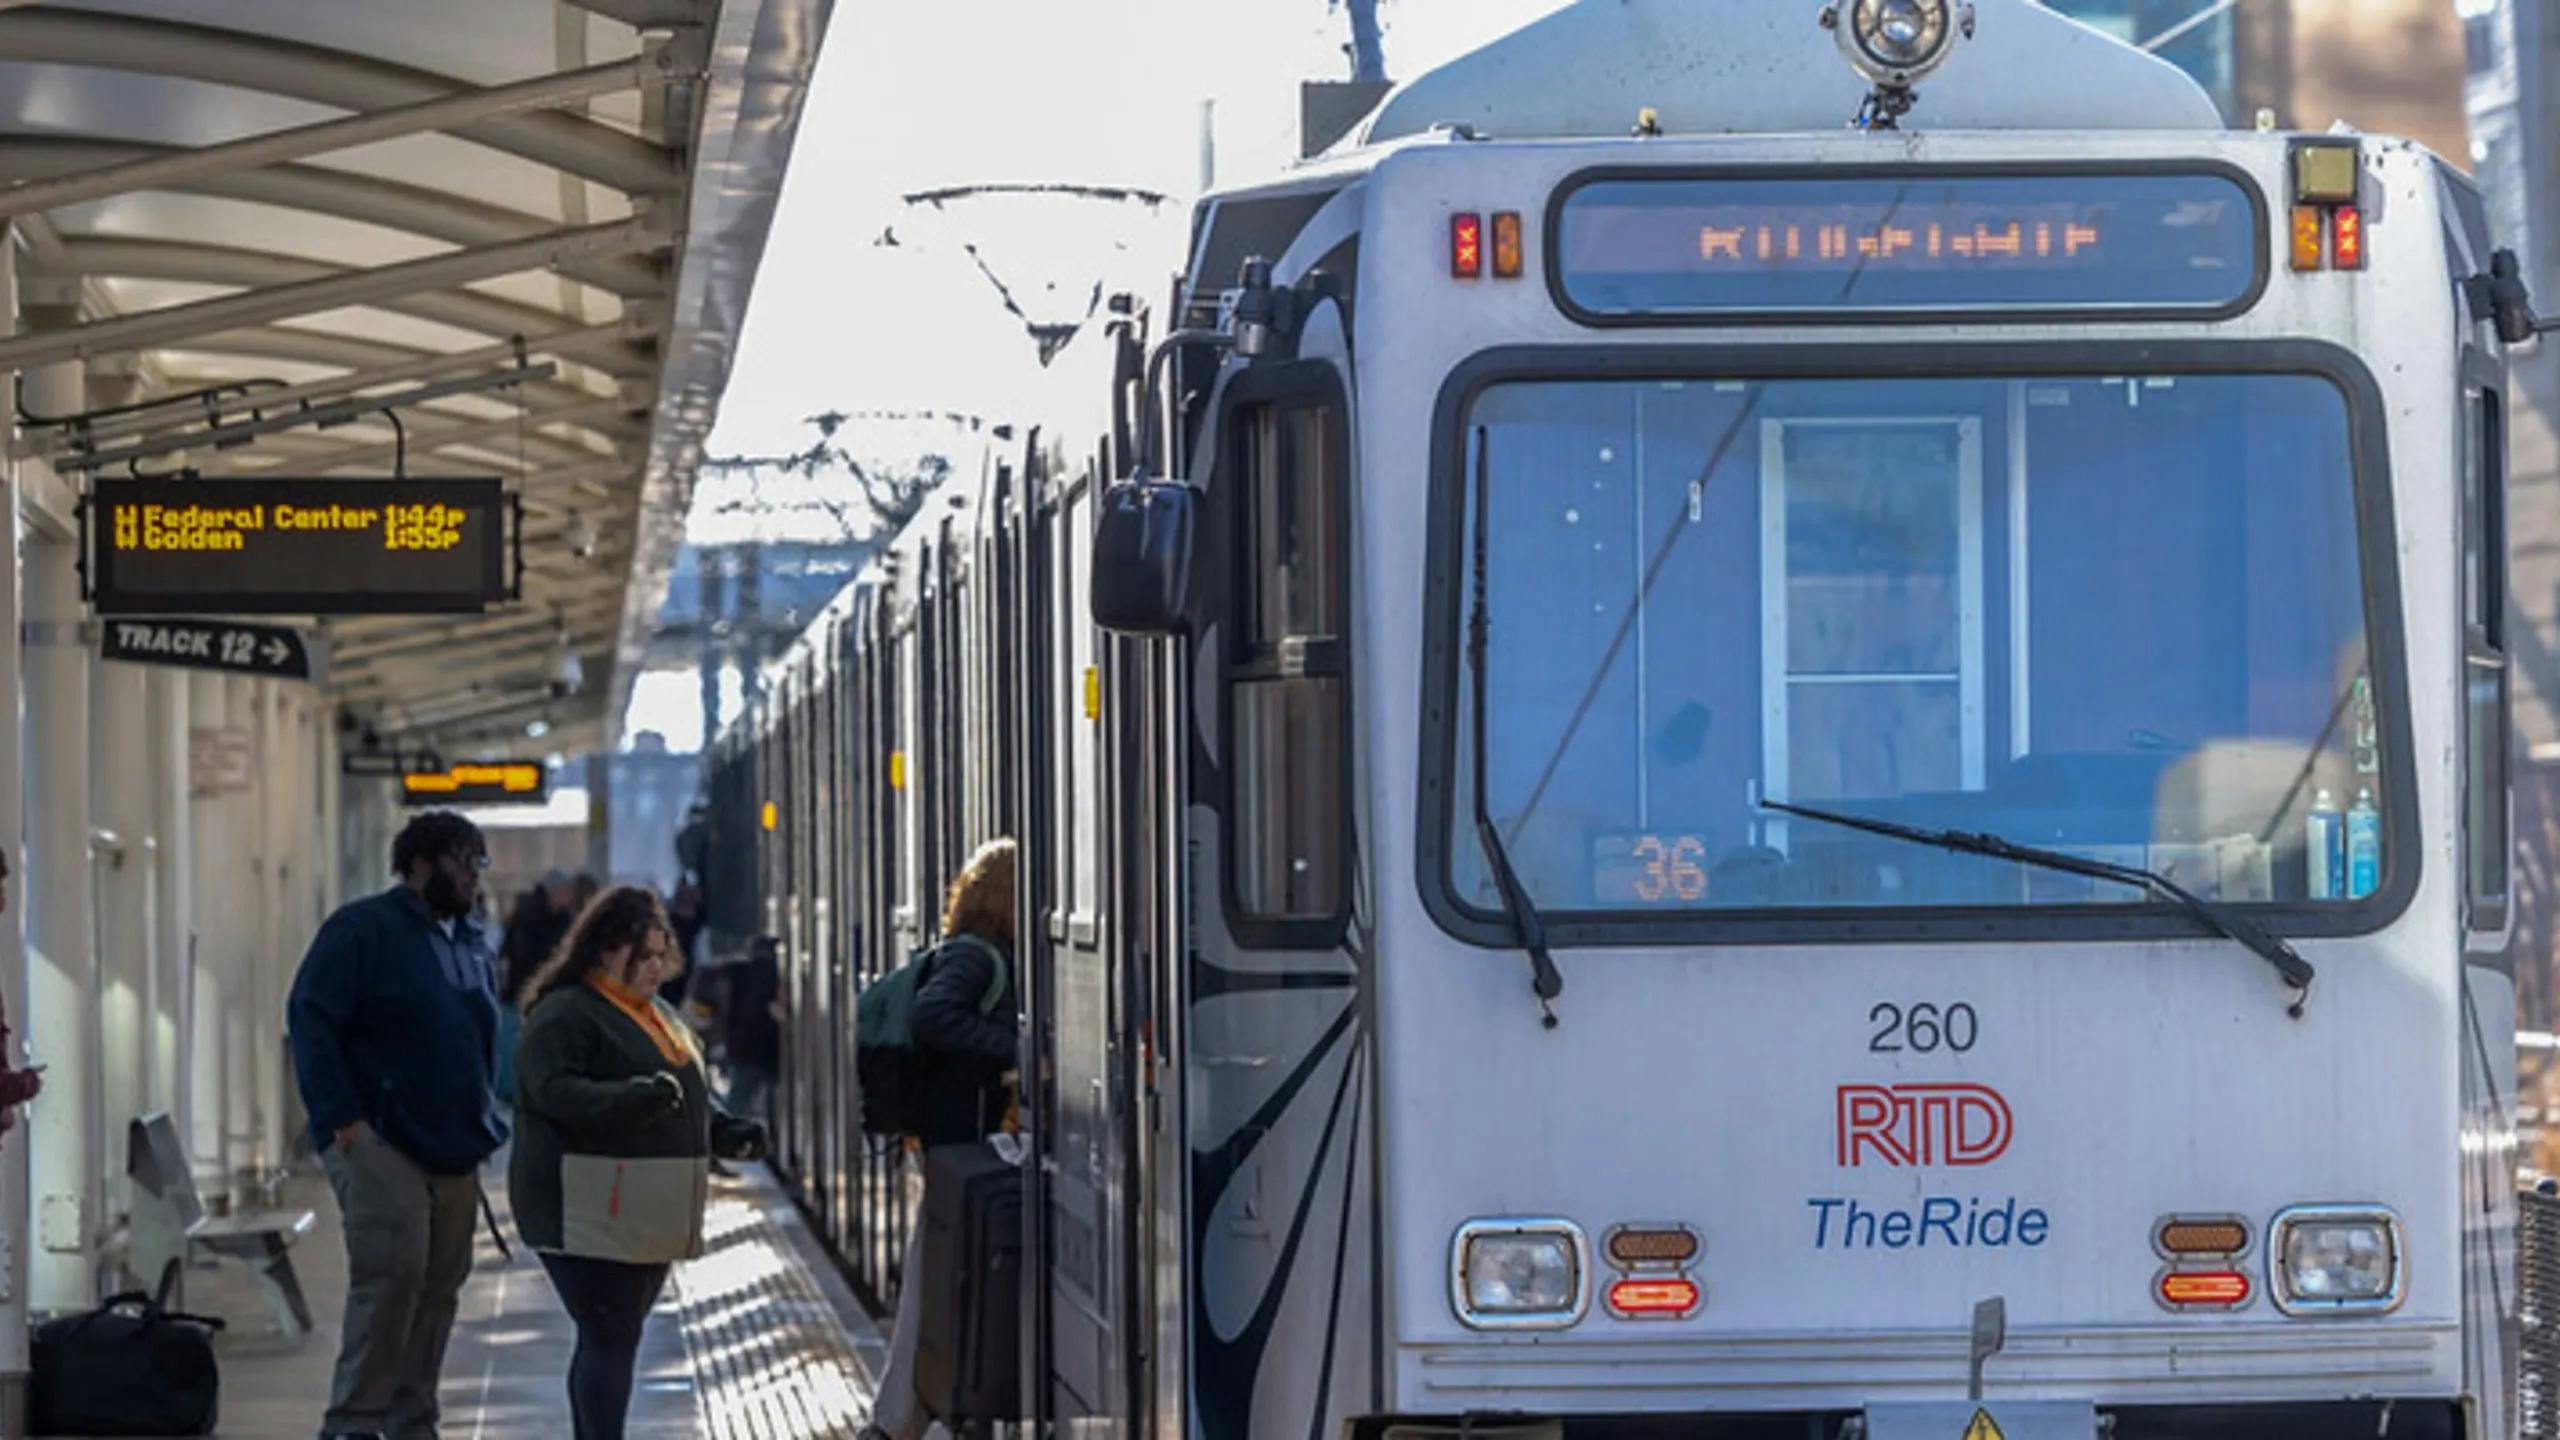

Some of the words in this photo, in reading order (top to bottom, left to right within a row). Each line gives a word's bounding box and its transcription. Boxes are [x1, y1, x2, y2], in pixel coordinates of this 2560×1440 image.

[143, 504, 264, 529] Federal
[273, 504, 379, 529] Center
[143, 526, 244, 550] Golden
[116, 624, 212, 655] TRACK
[220, 630, 256, 664] 12
[1632, 835, 1707, 901] 36
[1869, 1002, 1979, 1053] 260
[1836, 1082, 2013, 1167] RTD
[1807, 1197, 2049, 1249] TheRide
